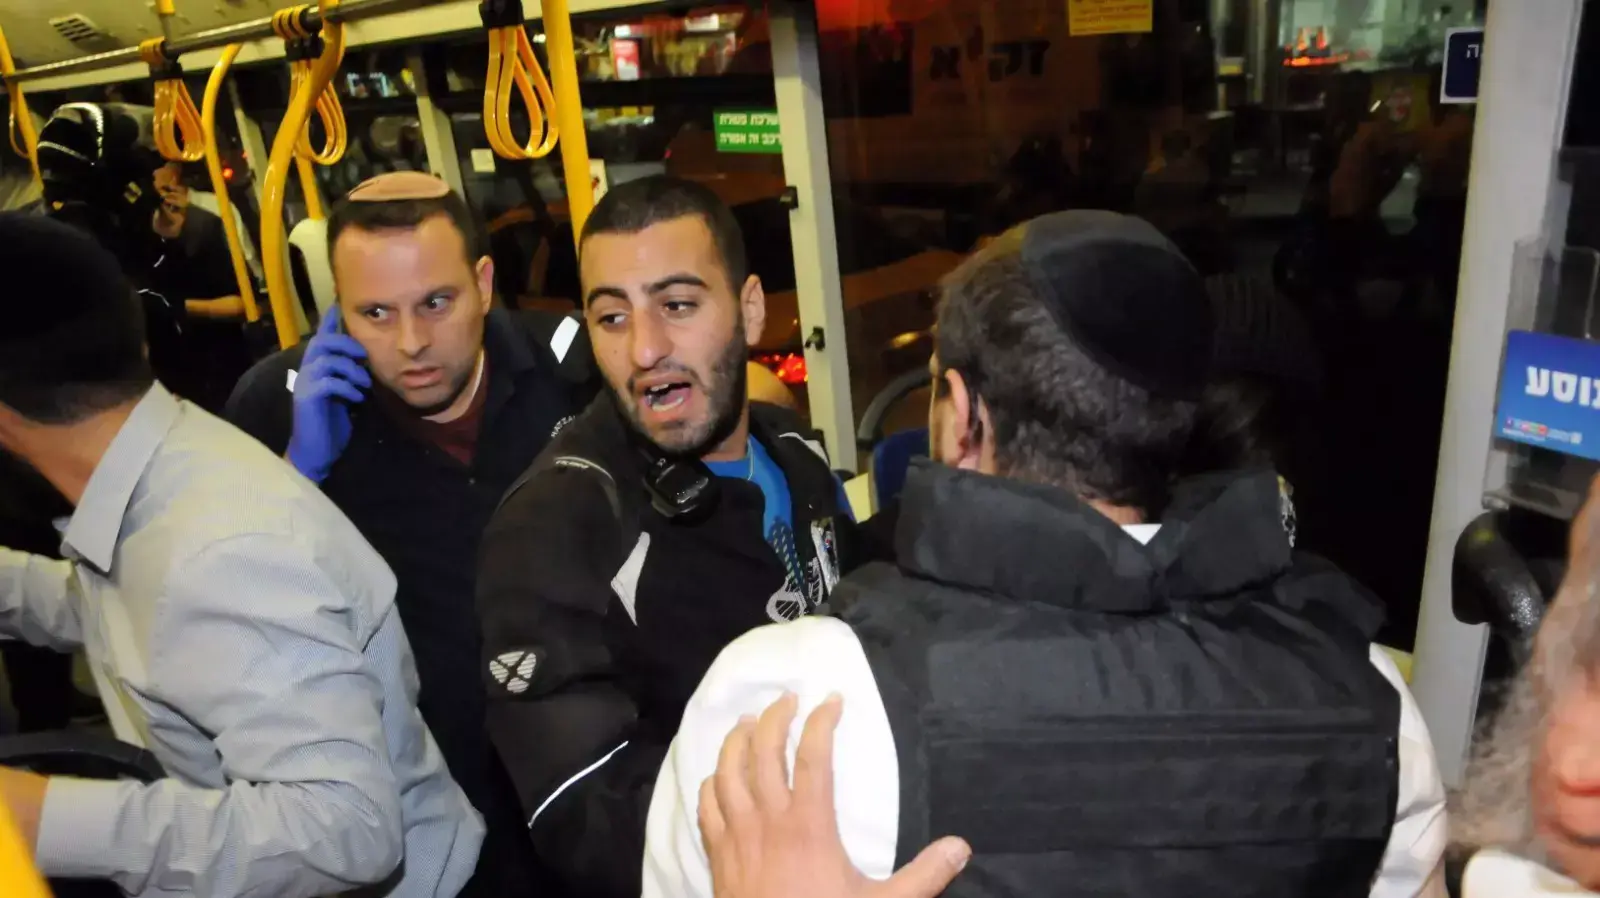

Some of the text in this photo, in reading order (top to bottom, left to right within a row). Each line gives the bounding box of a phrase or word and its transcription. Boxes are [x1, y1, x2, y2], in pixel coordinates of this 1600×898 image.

[751, 113, 778, 125] שלכת
[762, 132, 780, 145] רכב
[551, 415, 575, 437] HATZA
